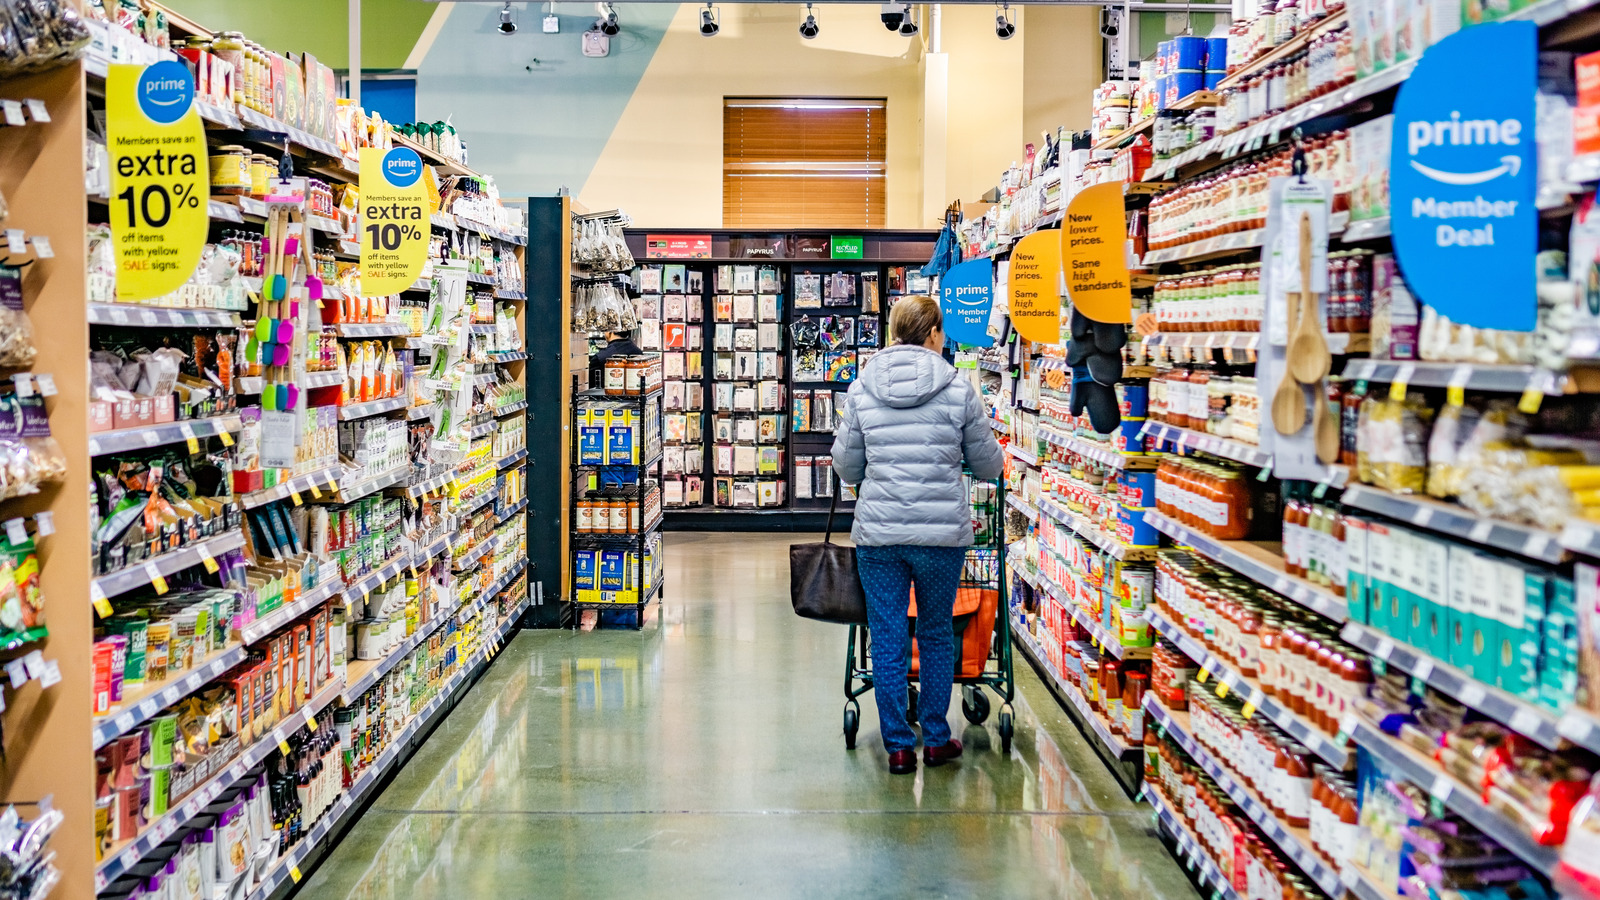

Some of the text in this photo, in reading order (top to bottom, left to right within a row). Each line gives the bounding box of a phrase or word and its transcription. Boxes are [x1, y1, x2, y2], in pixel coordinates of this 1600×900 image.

[146, 78, 186, 94] prime
[1408, 110, 1522, 156] prime
[116, 136, 160, 146] Members
[117, 149, 196, 177] extra
[388, 158, 416, 169] prime
[118, 183, 199, 228] 10%
[1412, 195, 1518, 219] Member
[366, 203, 422, 220] extra
[1068, 214, 1092, 222] New
[1069, 225, 1098, 234] lower
[1436, 223, 1495, 246] Deal
[122, 232, 164, 242] off items
[366, 223, 422, 250] 10%
[1070, 236, 1104, 248] prices.
[122, 246, 178, 258] with yellow
[122, 260, 150, 271] SALE
[386, 262, 408, 270] yellow
[1015, 262, 1039, 270] lower
[1072, 259, 1100, 268] Same
[1016, 272, 1042, 280] prices.
[1073, 271, 1096, 282] high
[956, 284, 988, 297] prime
[1074, 280, 1126, 292] standards.
[1015, 290, 1038, 298] Same
[1015, 300, 1034, 308] high
